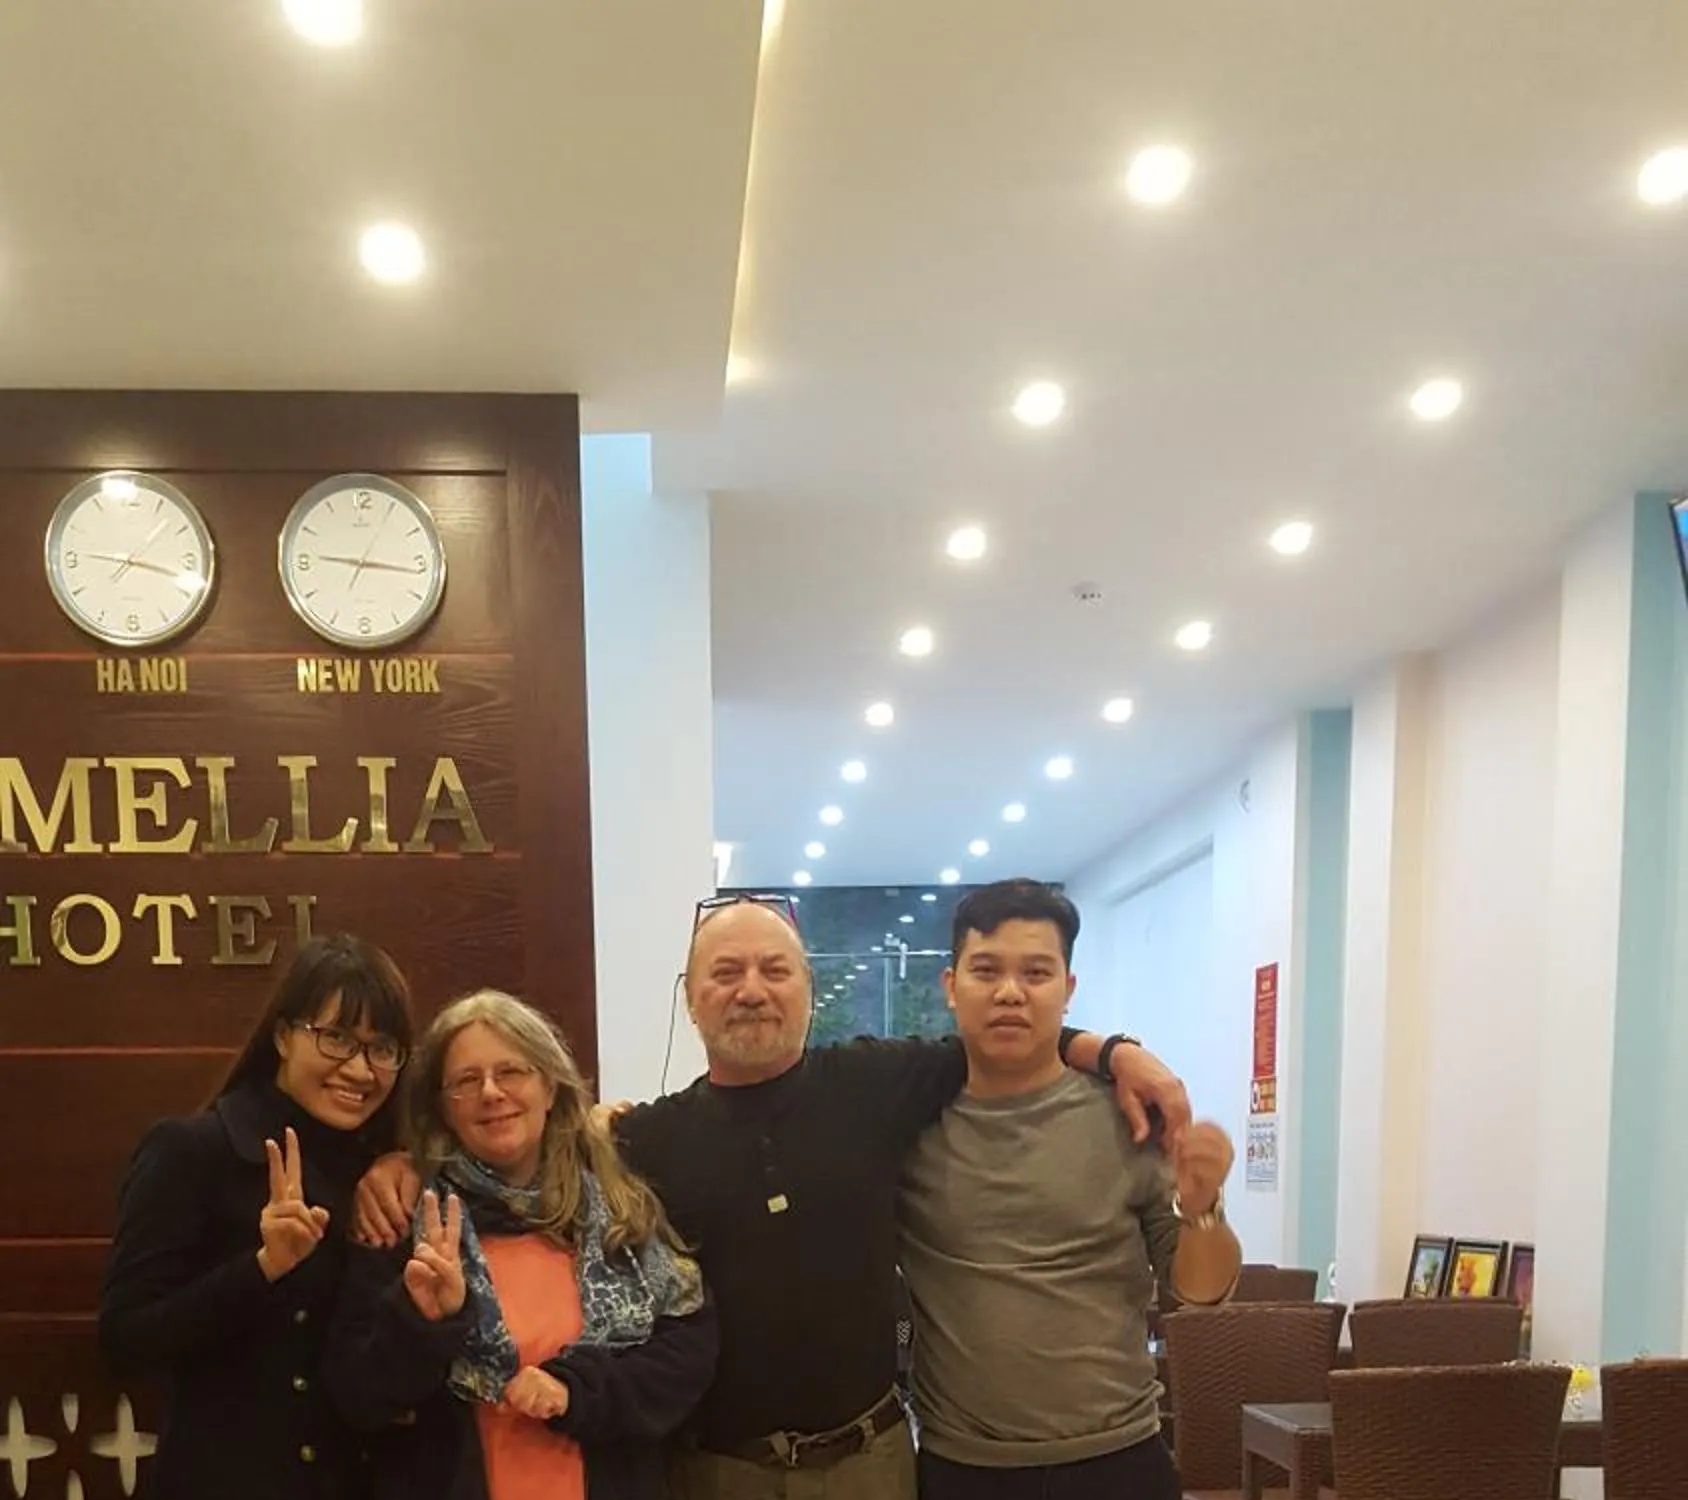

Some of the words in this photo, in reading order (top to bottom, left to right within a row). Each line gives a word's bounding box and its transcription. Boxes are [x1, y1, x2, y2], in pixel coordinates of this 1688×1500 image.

[297, 658, 361, 692] NEW
[369, 658, 441, 693] YORK
[0, 755, 495, 854] MELLIA
